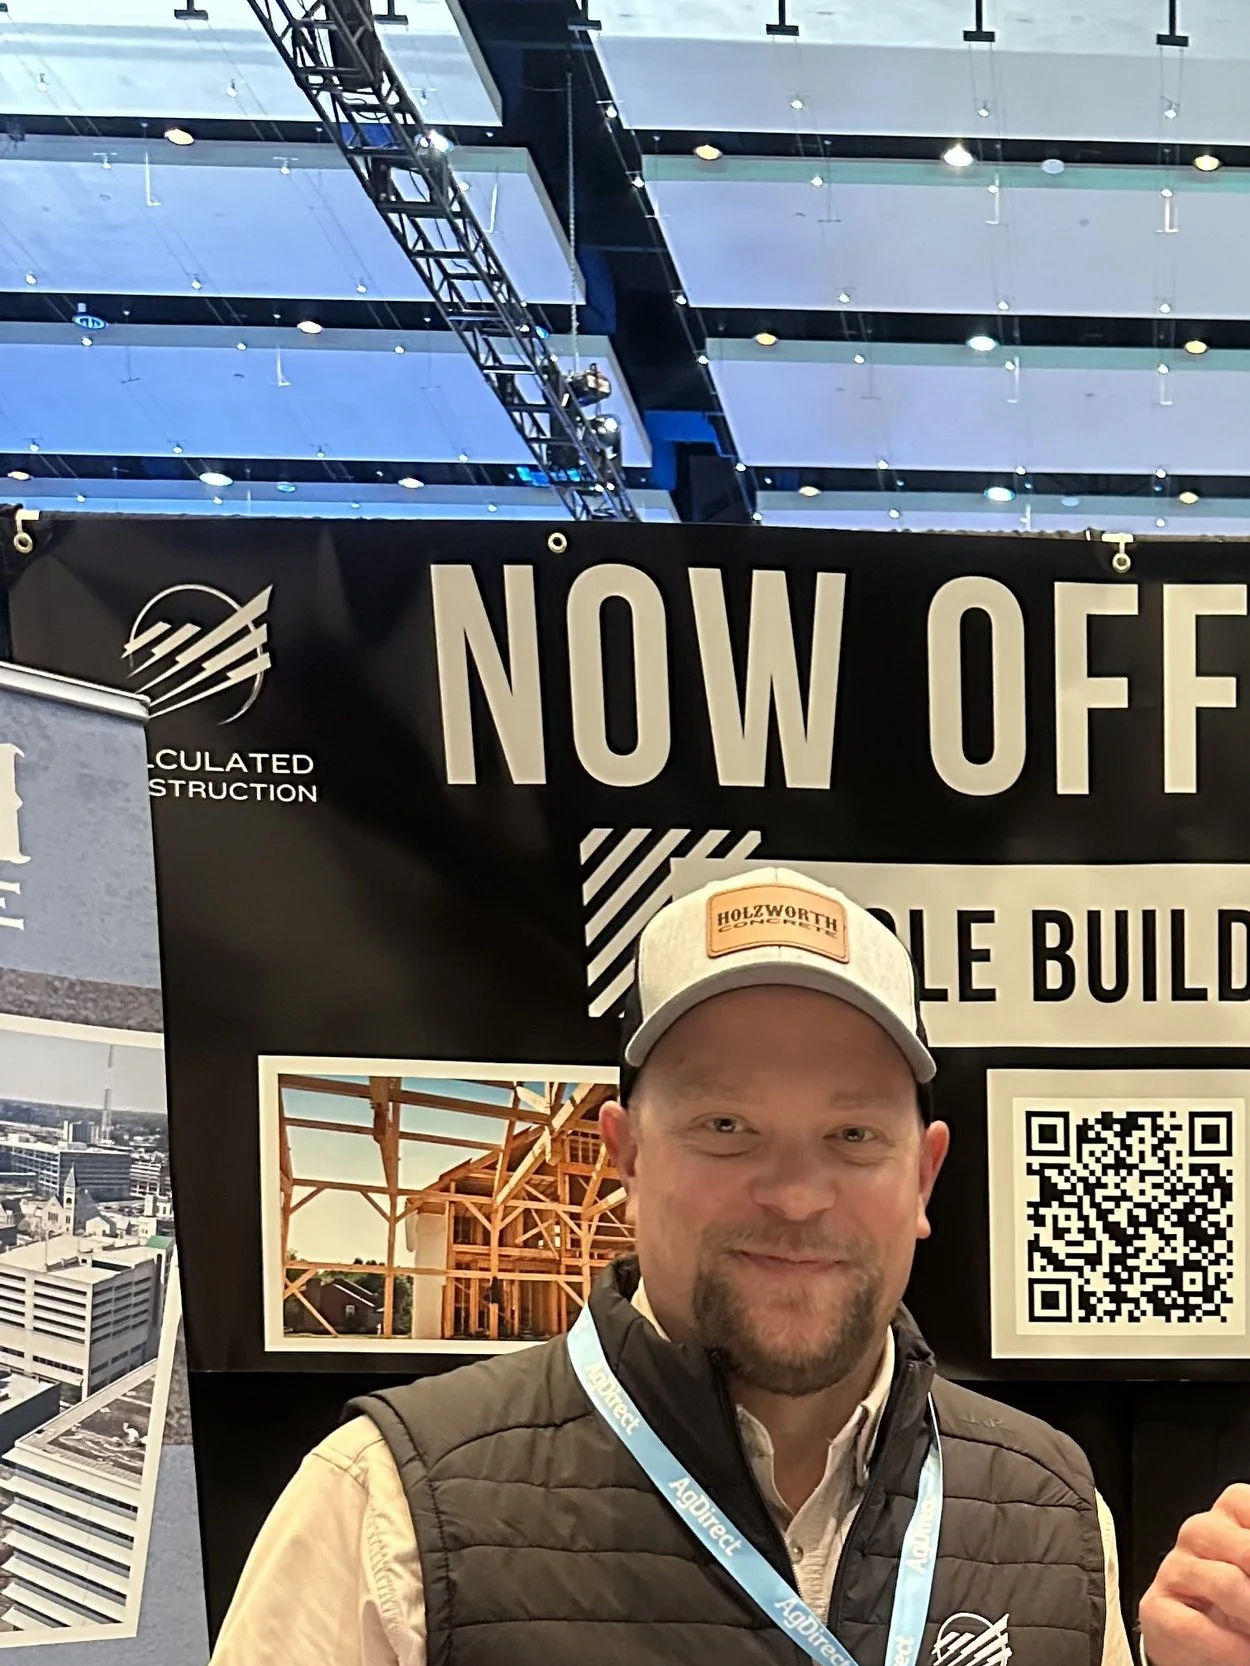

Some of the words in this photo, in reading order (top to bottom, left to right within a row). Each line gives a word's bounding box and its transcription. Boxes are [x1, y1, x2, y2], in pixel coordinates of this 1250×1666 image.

[430, 563, 846, 790] NOW
[147, 749, 314, 774] CULATED
[148, 778, 317, 802] STRUCTION
[717, 904, 838, 932] HOLZWORTH
[718, 918, 838, 938] CONCRETE
[866, 907, 996, 1003] LE
[584, 1362, 641, 1436] AgDirect
[668, 1477, 742, 1556] AgDirect
